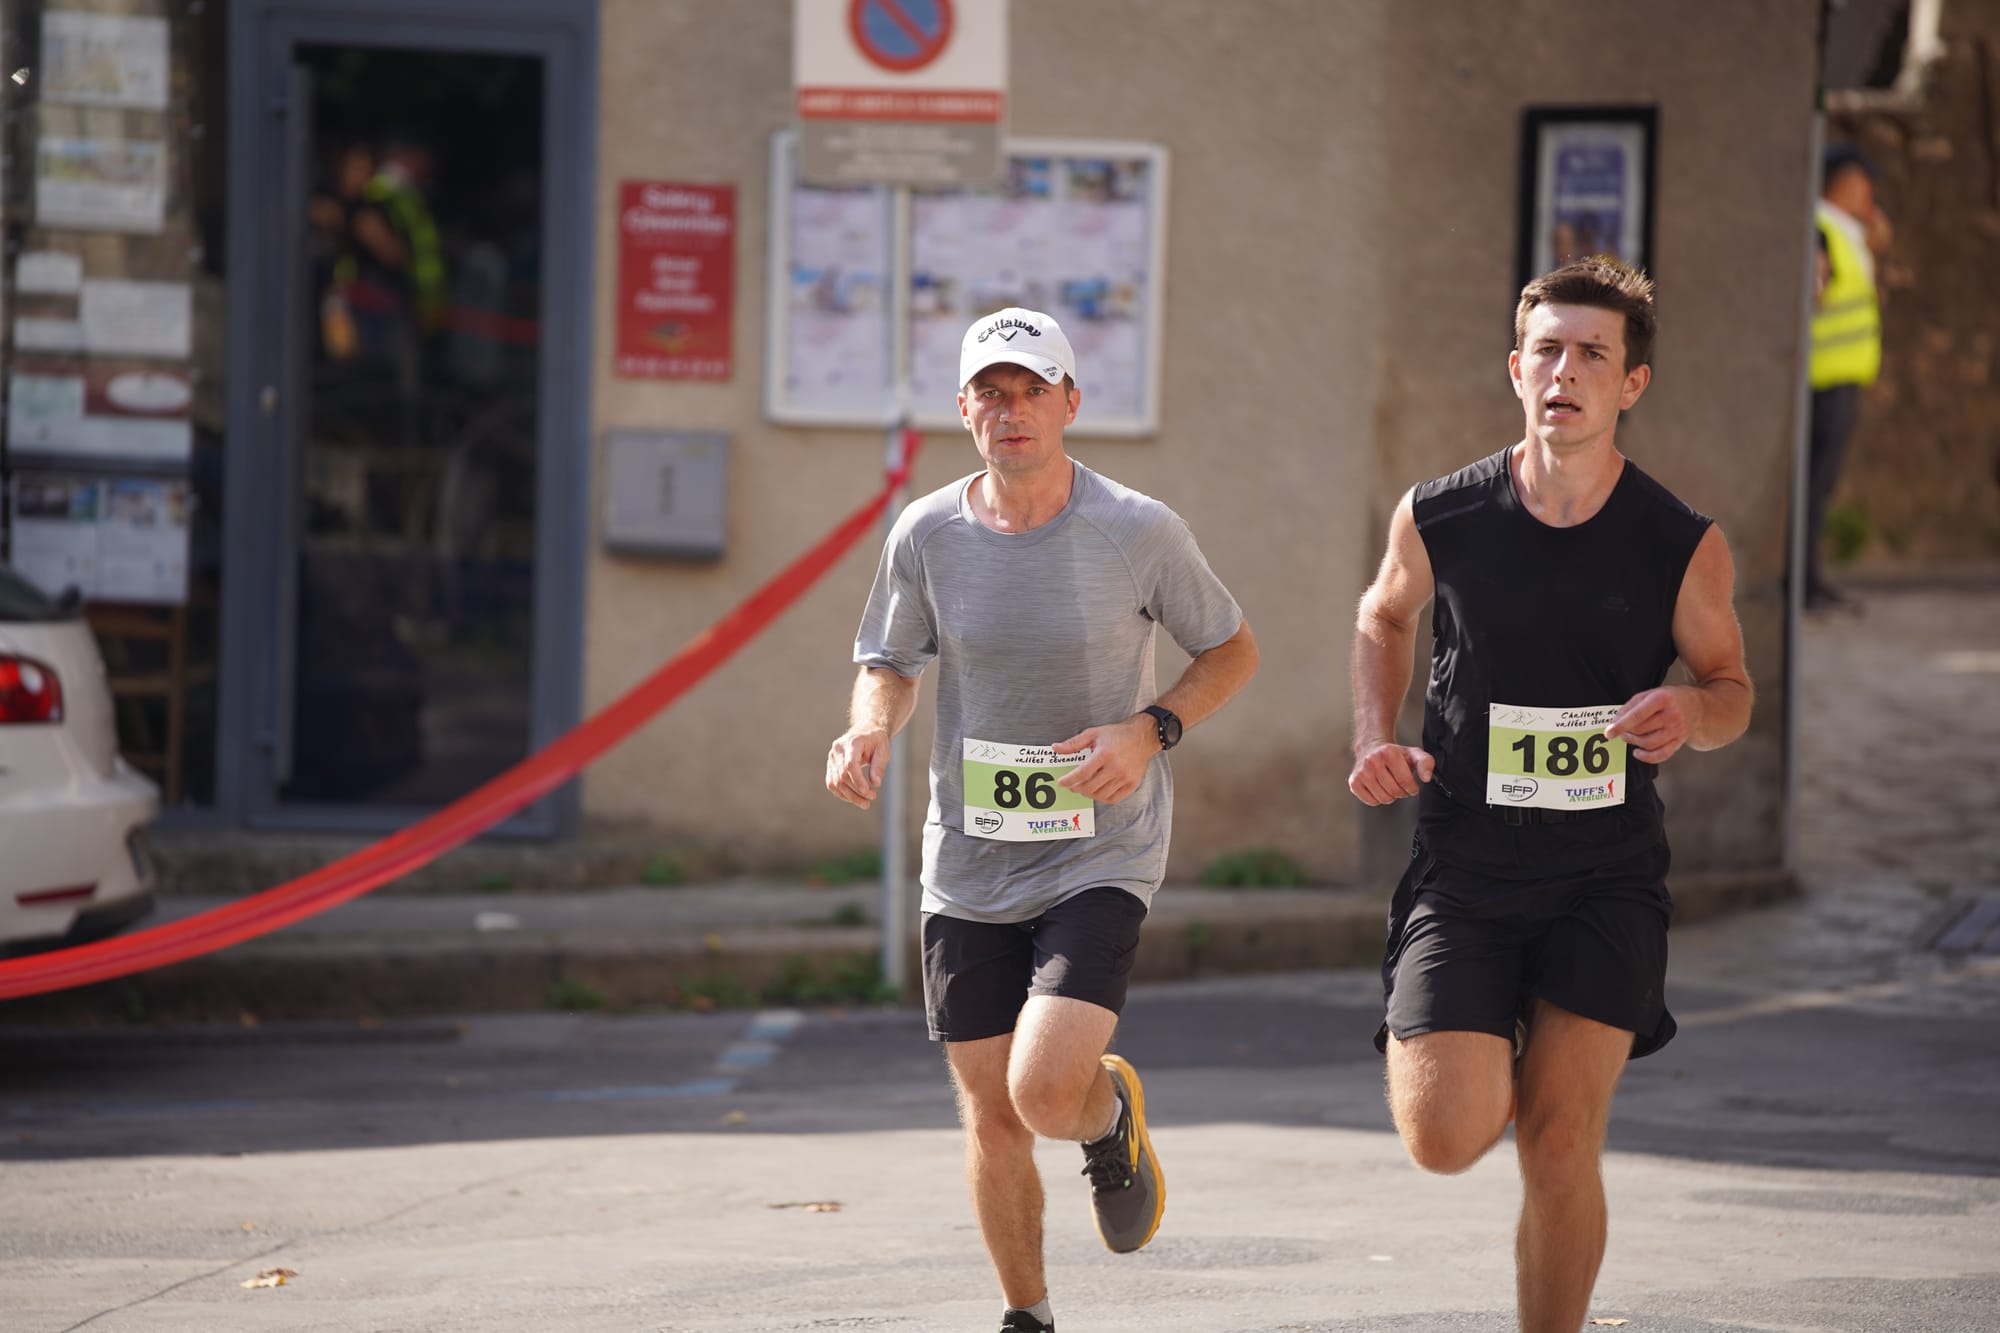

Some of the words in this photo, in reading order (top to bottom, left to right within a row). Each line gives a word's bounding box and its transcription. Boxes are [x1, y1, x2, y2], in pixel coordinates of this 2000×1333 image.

[978, 319, 1041, 342] Callaway
[1561, 711, 1602, 721] Challenge
[1019, 748, 1059, 757] Challeng
[1512, 733, 1610, 776] 186
[994, 770, 1057, 809] 86
[1502, 784, 1532, 794] BFP
[1565, 785, 1605, 797] TUFF'S
[1569, 793, 1608, 802] Aventure
[975, 817, 999, 827] BFP
[1027, 819, 1068, 829] TUFF'S
[1031, 825, 1073, 834] Aventure
